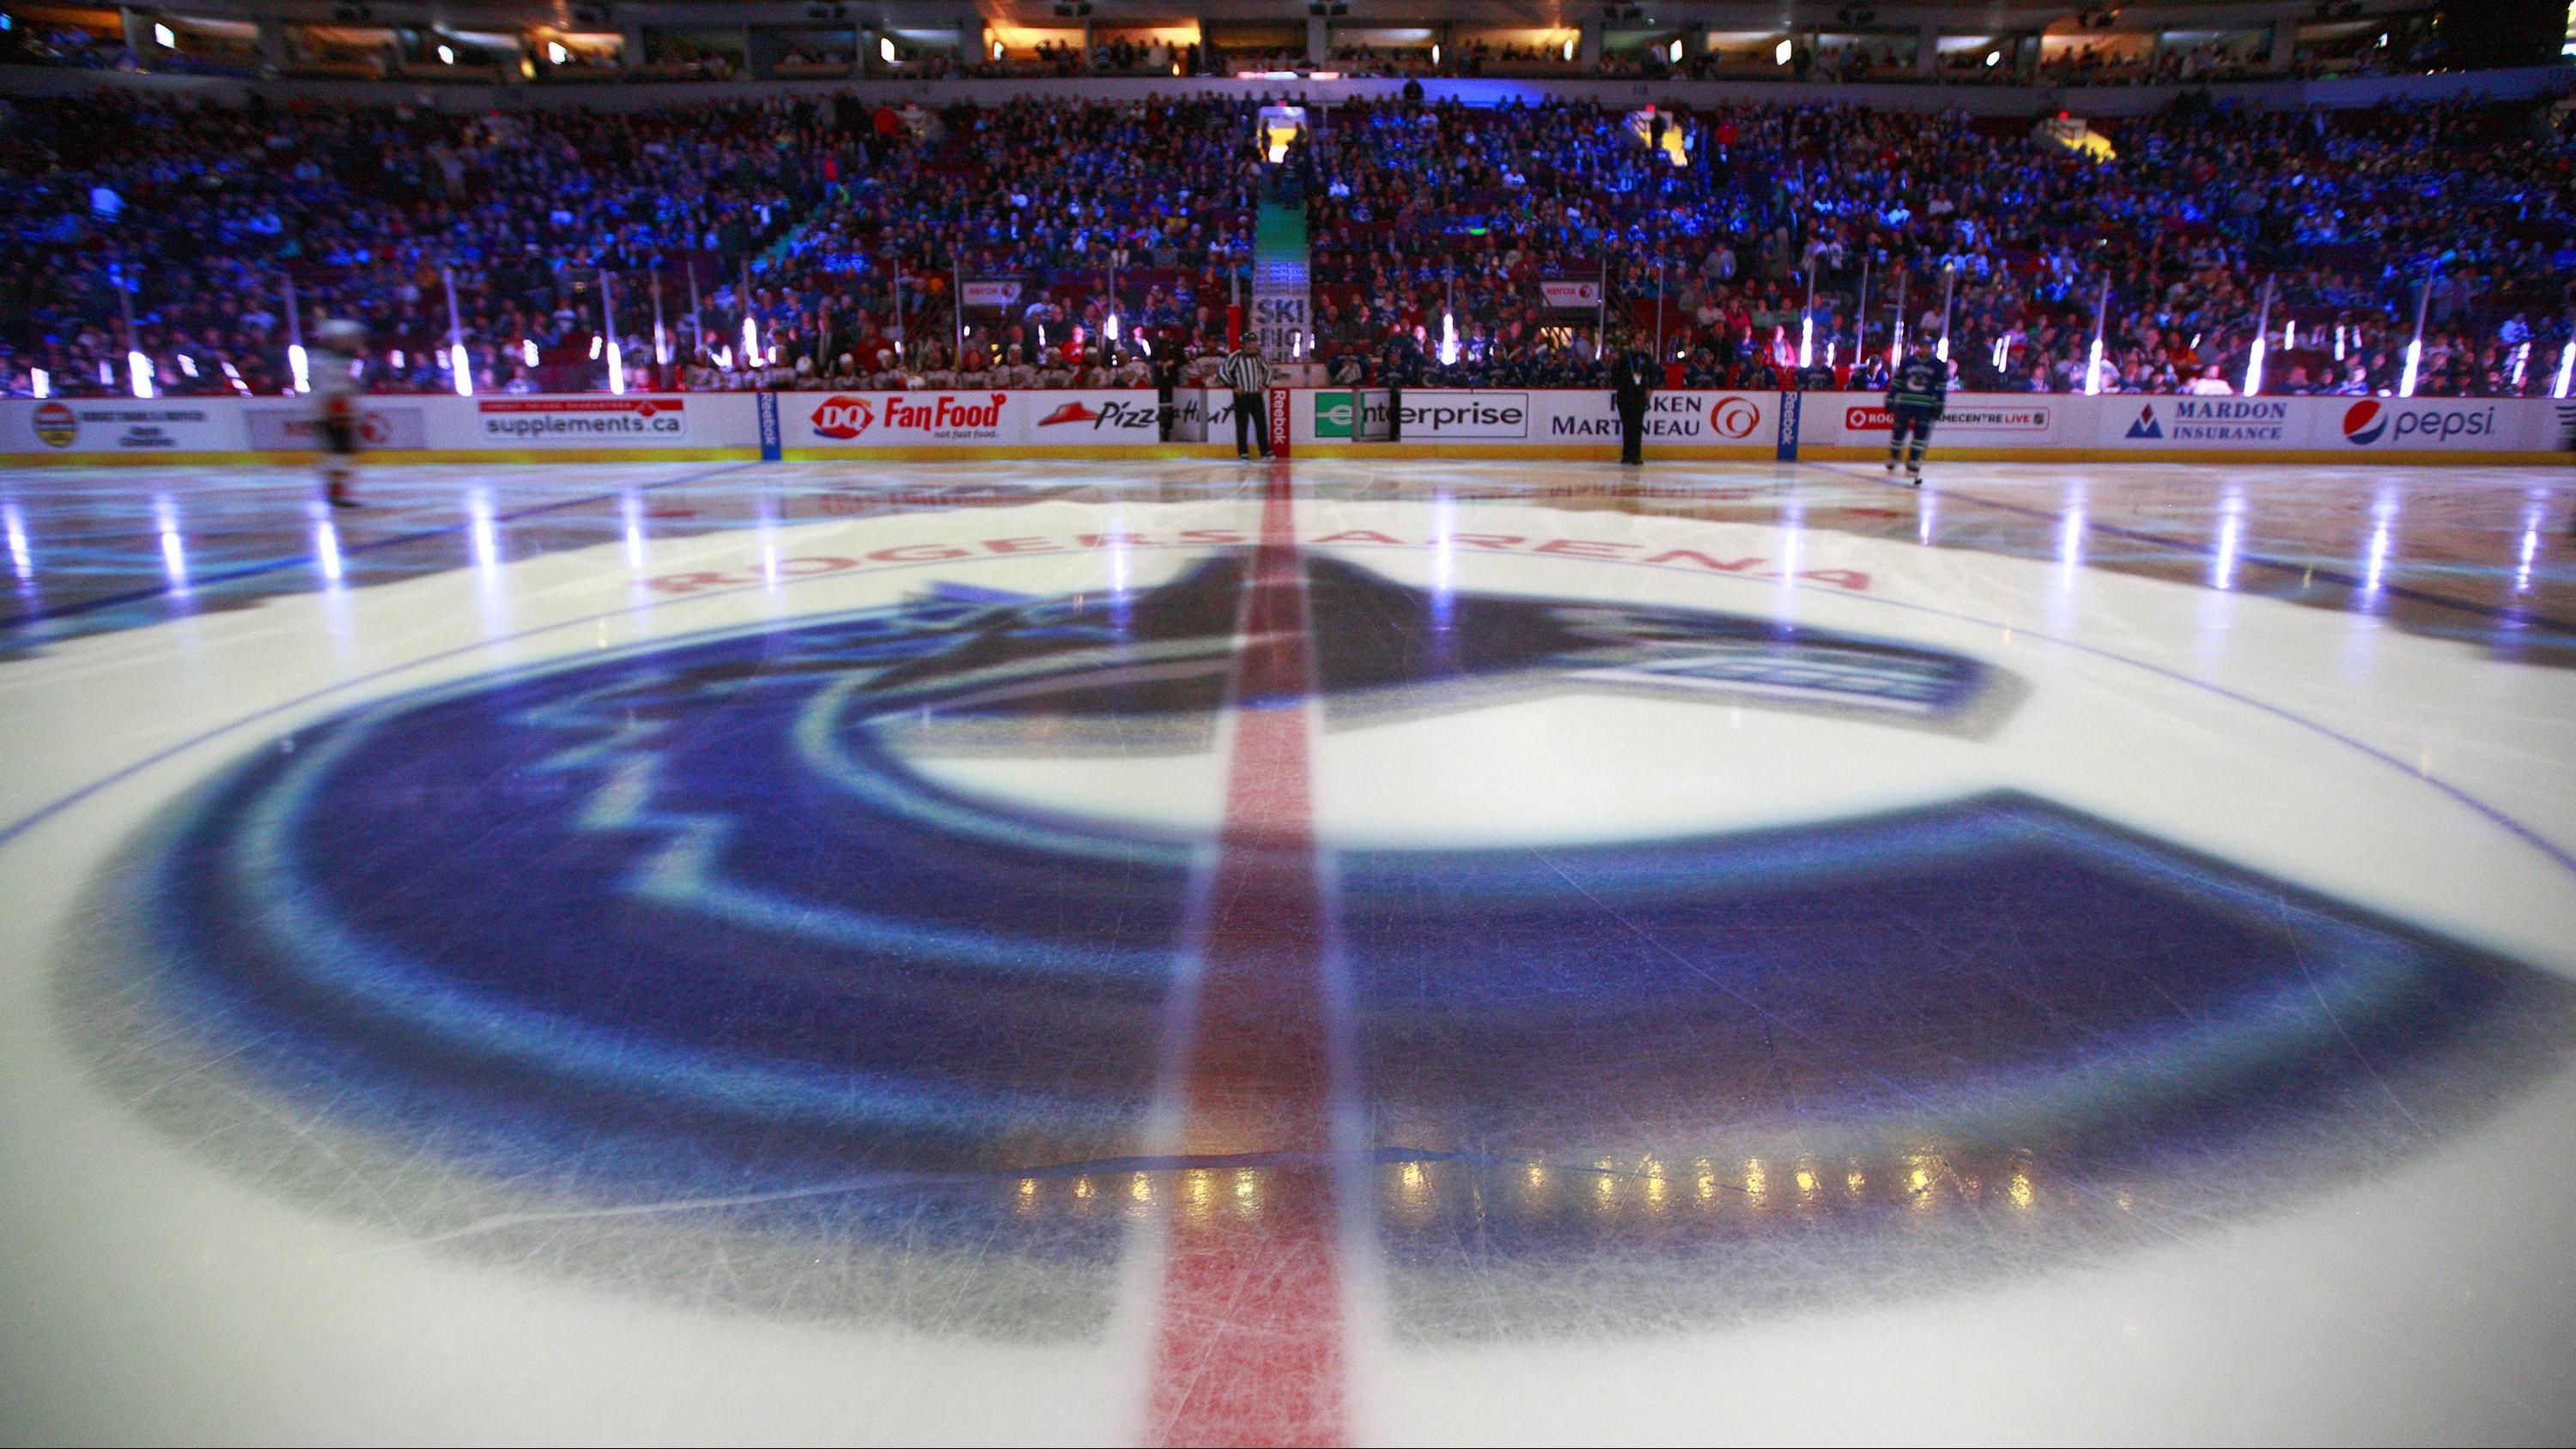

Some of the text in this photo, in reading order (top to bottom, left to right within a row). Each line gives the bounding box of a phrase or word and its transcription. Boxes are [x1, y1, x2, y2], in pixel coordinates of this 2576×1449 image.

[1256, 299, 1304, 324] SKI
[760, 393, 777, 446] Reebok
[822, 404, 866, 429] DQ
[1273, 390, 1288, 445] Reebok
[1782, 391, 1798, 446] Reebok
[2005, 414, 2031, 424] LIVE
[2175, 401, 2287, 419] MARDON
[485, 414, 681, 436] supplements.ca
[1551, 415, 1701, 436] MARTNEAU
[2172, 426, 2284, 441] INSURANCE
[2392, 406, 2495, 442] pepsi
[635, 529, 1874, 593] ROGERS ARENA
